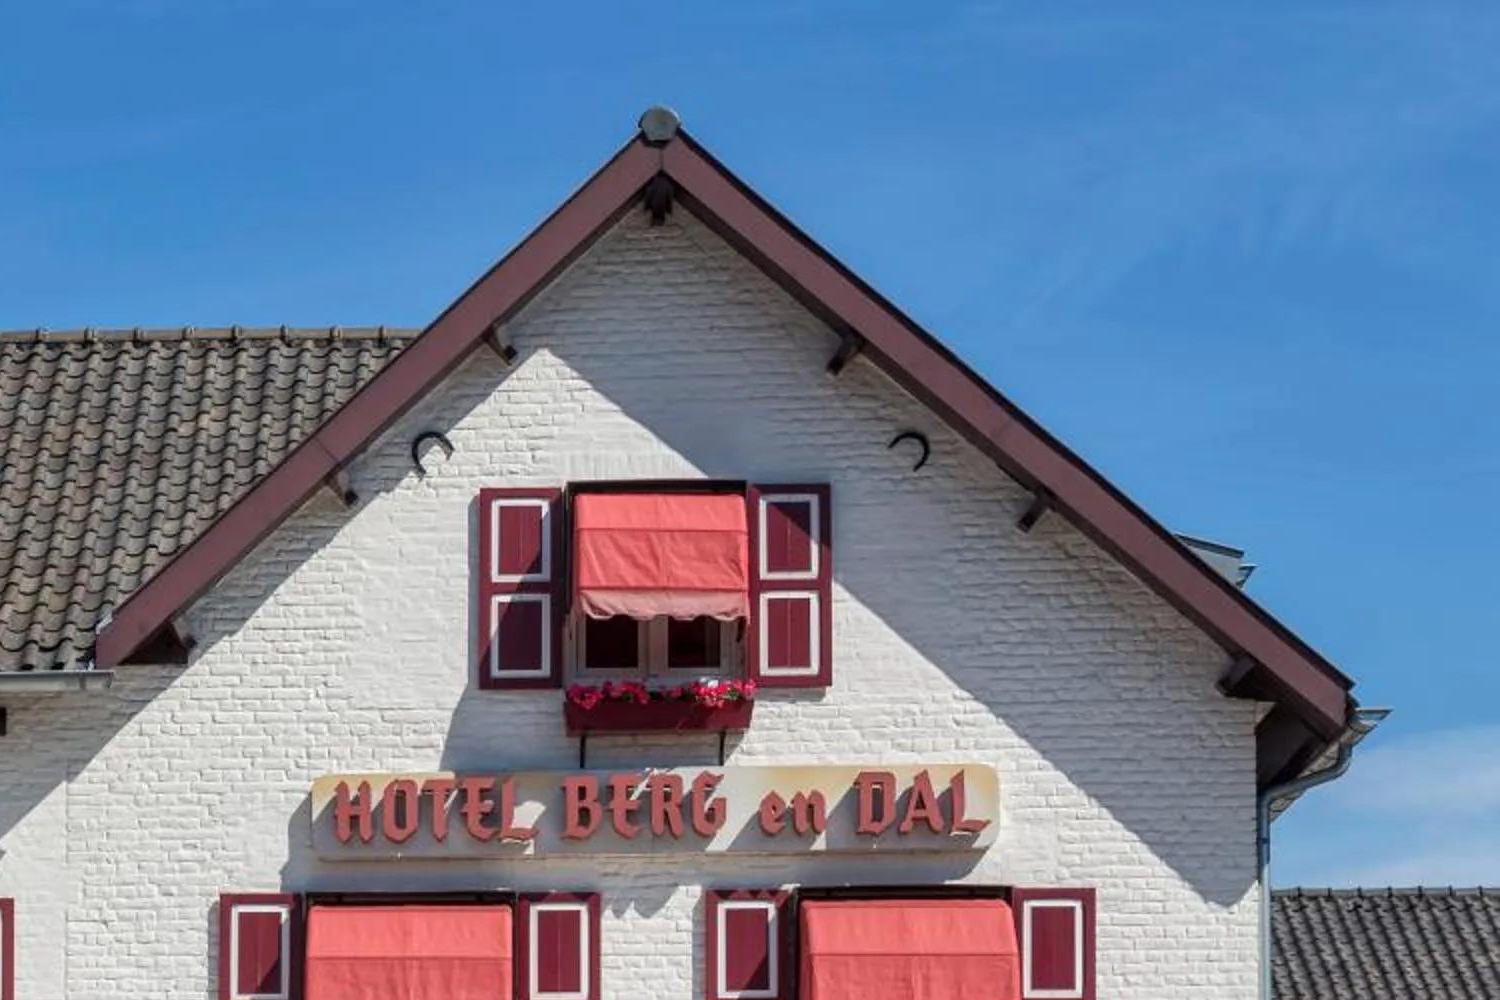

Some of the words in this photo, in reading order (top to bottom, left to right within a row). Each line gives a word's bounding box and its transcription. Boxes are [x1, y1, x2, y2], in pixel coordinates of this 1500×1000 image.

[334, 776, 540, 845] HOTEL
[561, 769, 728, 841] BERG
[760, 785, 827, 836] en
[854, 769, 992, 836] DAL
